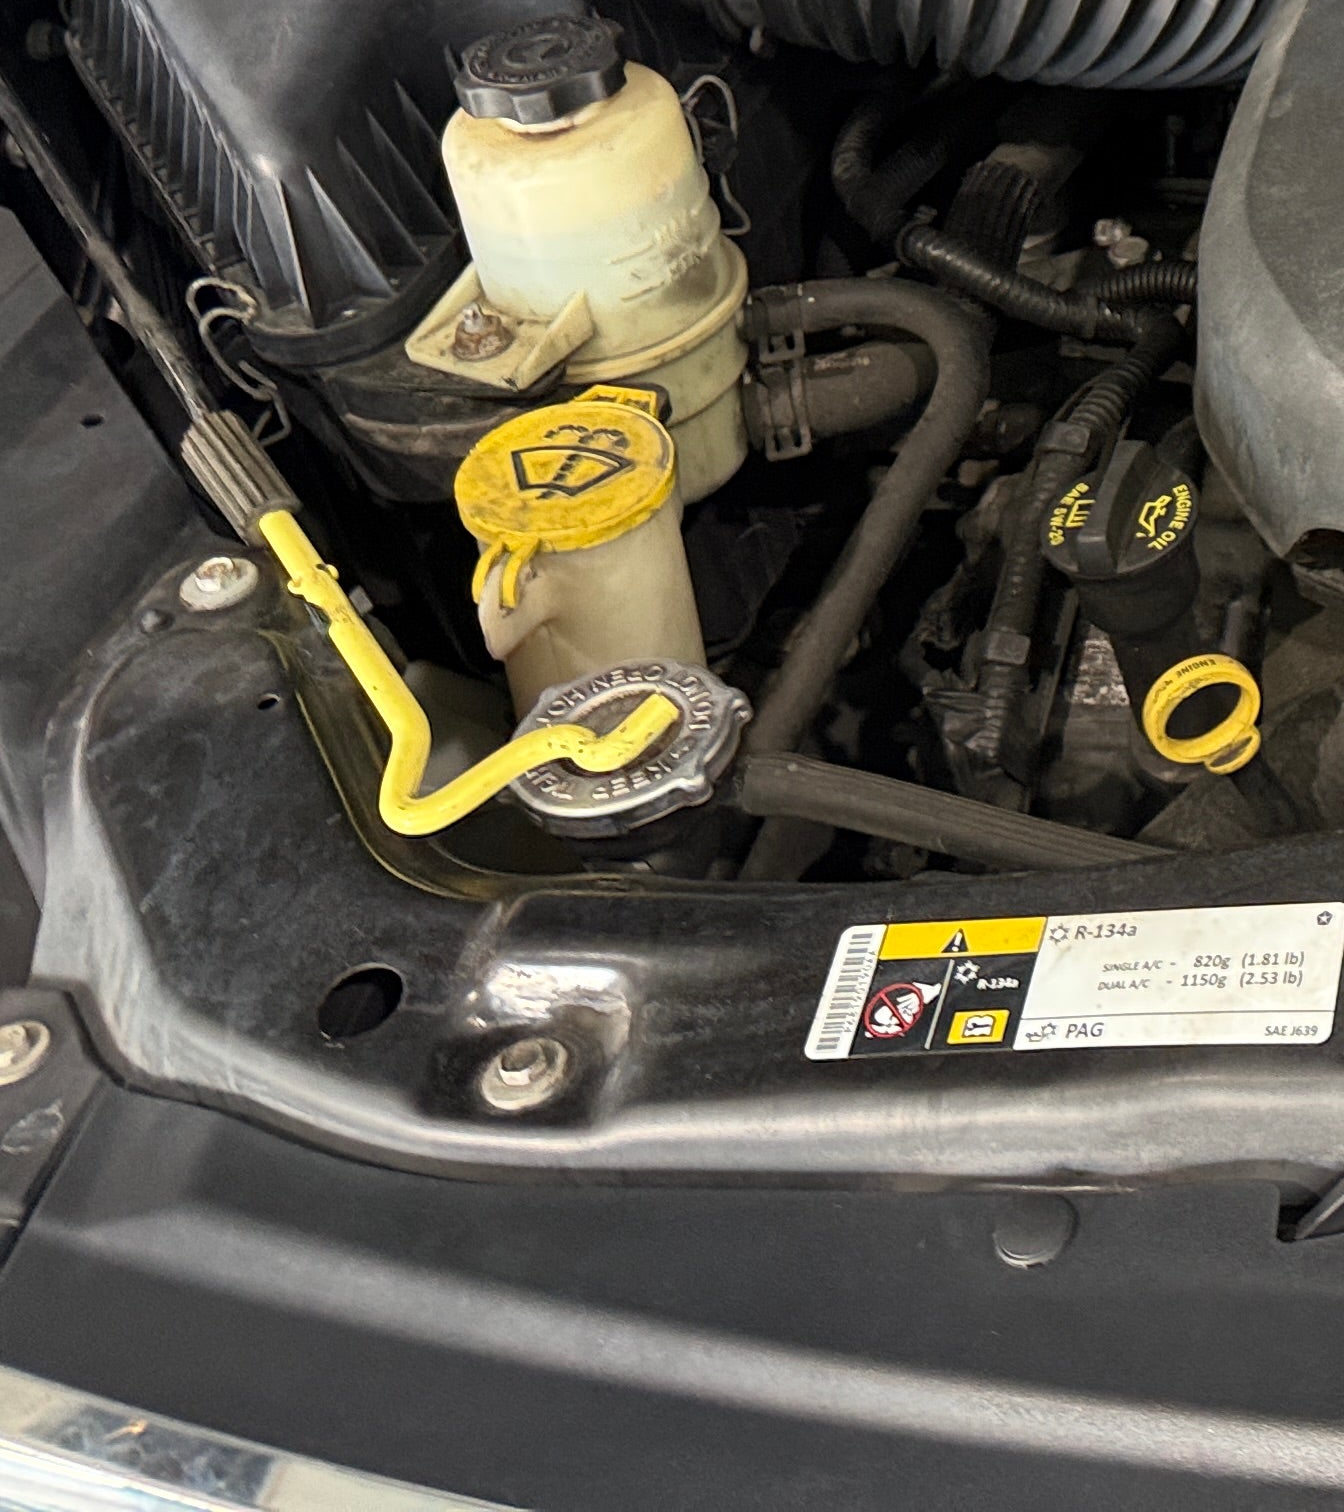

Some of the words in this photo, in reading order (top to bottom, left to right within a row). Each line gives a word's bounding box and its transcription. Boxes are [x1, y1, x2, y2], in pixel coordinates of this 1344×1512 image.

[1060, 482, 1090, 506] SAE
[1168, 484, 1192, 530] ENGINE
[1147, 530, 1177, 550] OIL
[590, 665, 665, 694] OPEN
[591, 760, 673, 800] KEEP
[1074, 922, 1138, 940] R-134a
[1101, 961, 1141, 973] SINGLE
[1143, 959, 1164, 971] A/C
[1193, 954, 1231, 970] 820g
[1241, 953, 1280, 969] (1.81
[1284, 951, 1305, 968] lb)
[1097, 978, 1128, 991] DUAL
[1129, 977, 1151, 990] A/C
[1180, 973, 1228, 989] 1150g
[1239, 971, 1279, 988] (2.53
[1282, 970, 1303, 987] lb)
[1065, 1022, 1105, 1040] PAG
[1264, 1024, 1288, 1037] SAE
[1290, 1024, 1319, 1037] J639
